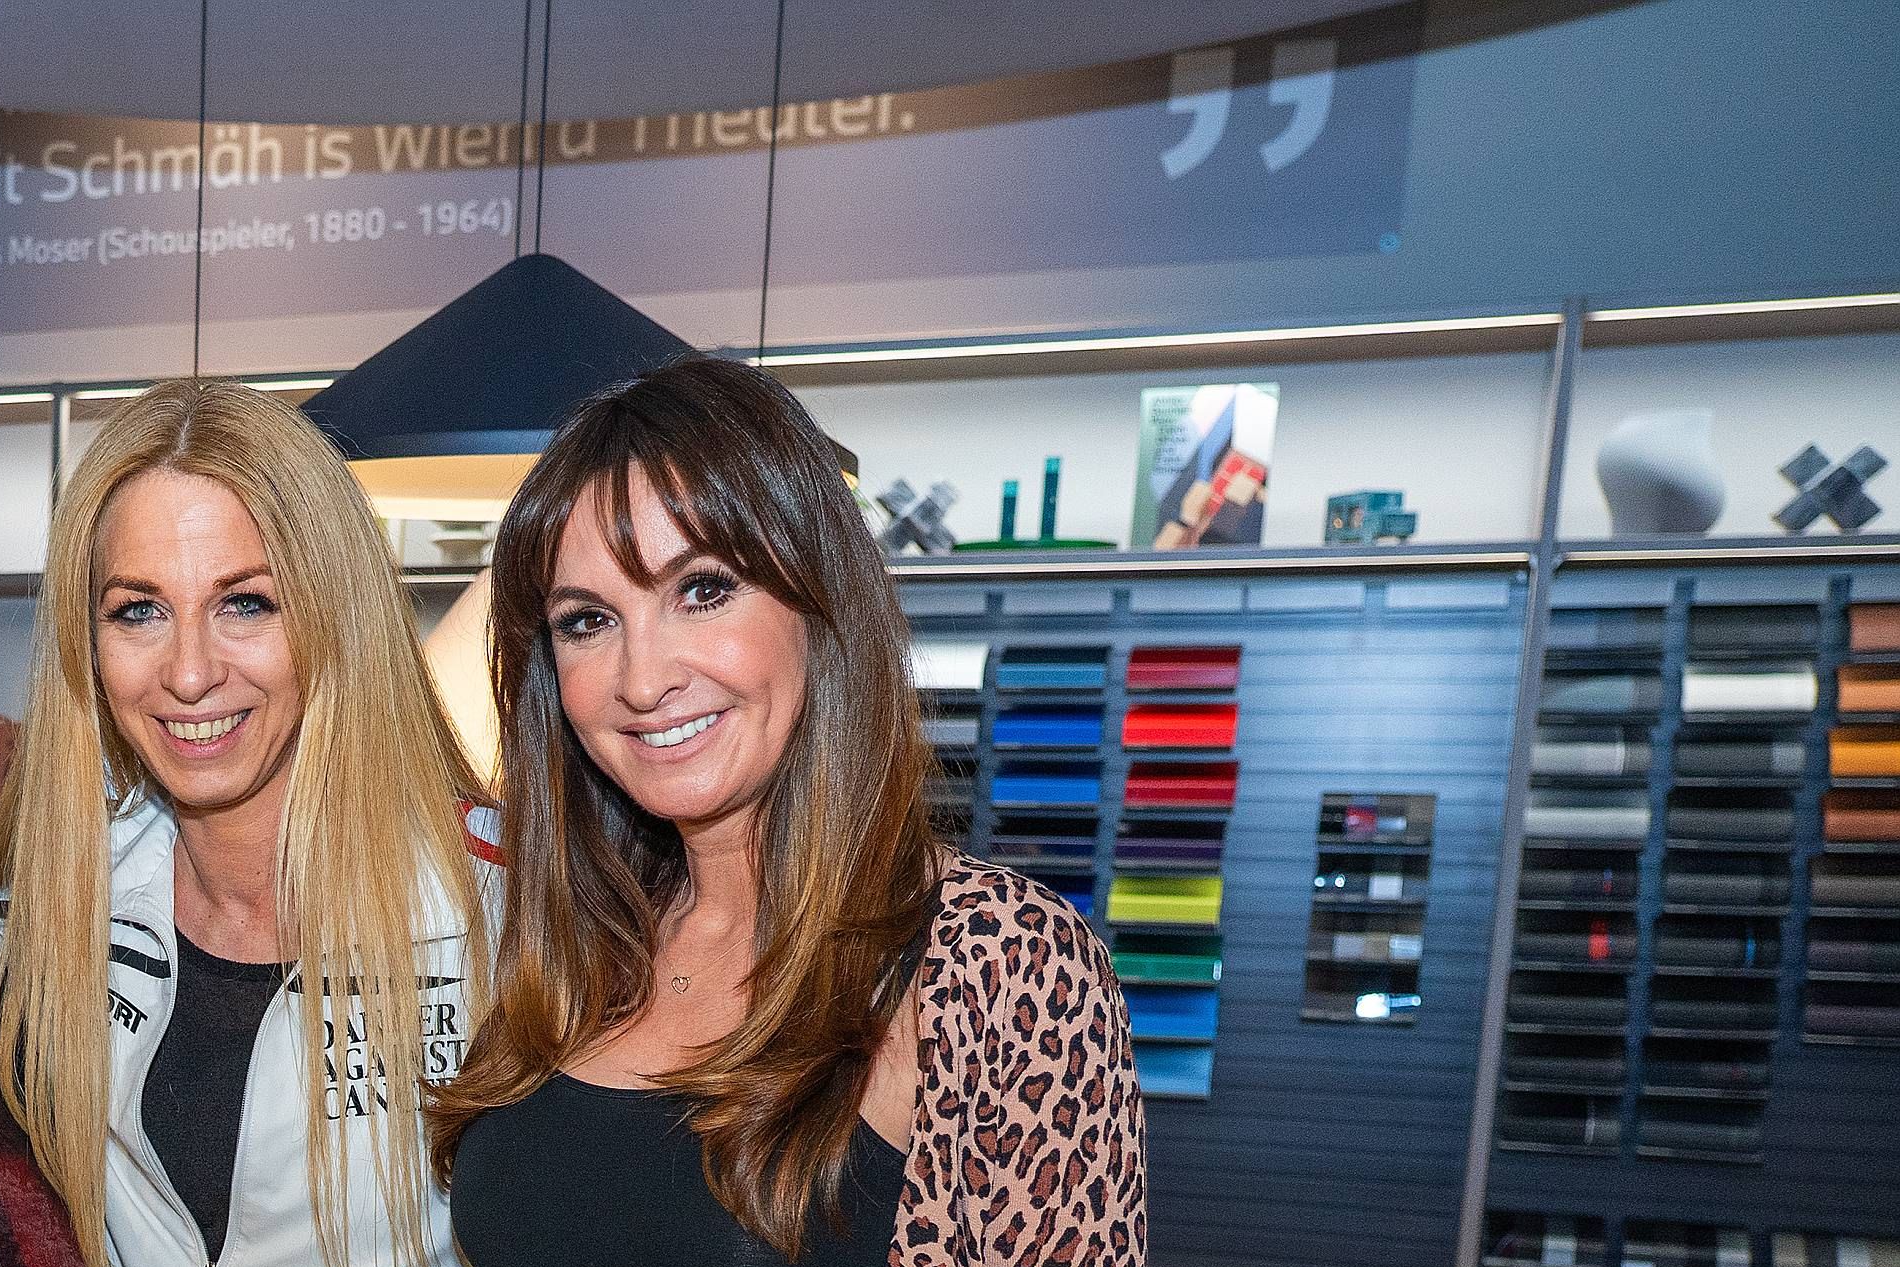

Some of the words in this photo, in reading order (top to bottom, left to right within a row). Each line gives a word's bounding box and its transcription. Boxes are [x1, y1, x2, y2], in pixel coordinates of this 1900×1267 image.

[41, 122, 282, 203] Schmäh
[305, 124, 353, 181] is
[7, 234, 95, 265] Moser
[99, 213, 296, 266] (Schauspieler,
[303, 206, 386, 243] 1880
[418, 197, 515, 238] 1964)
